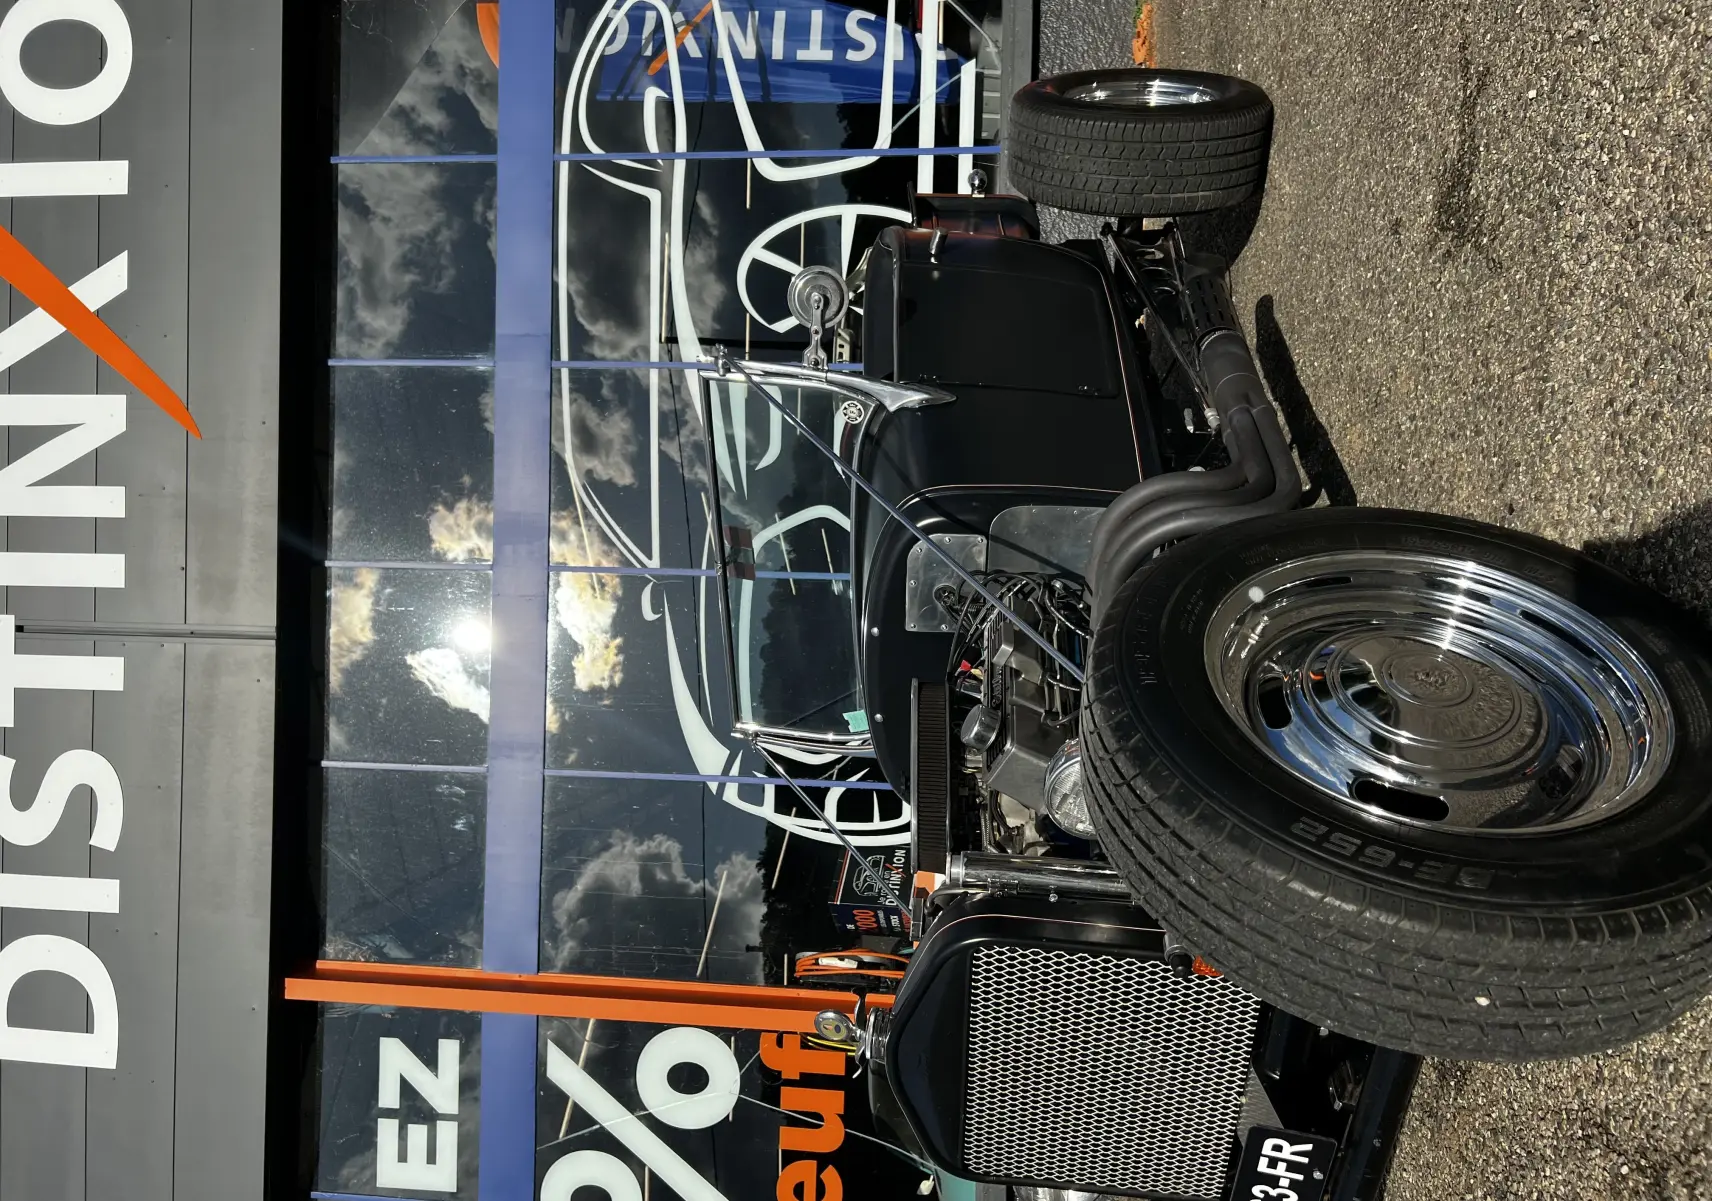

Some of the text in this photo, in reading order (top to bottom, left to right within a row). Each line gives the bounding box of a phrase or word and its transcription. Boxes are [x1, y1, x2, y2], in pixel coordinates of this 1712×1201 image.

[376, 1037, 460, 1192] EZ
[760, 1032, 847, 1201] euf
[1250, 1138, 1314, 1201] 3-FR
